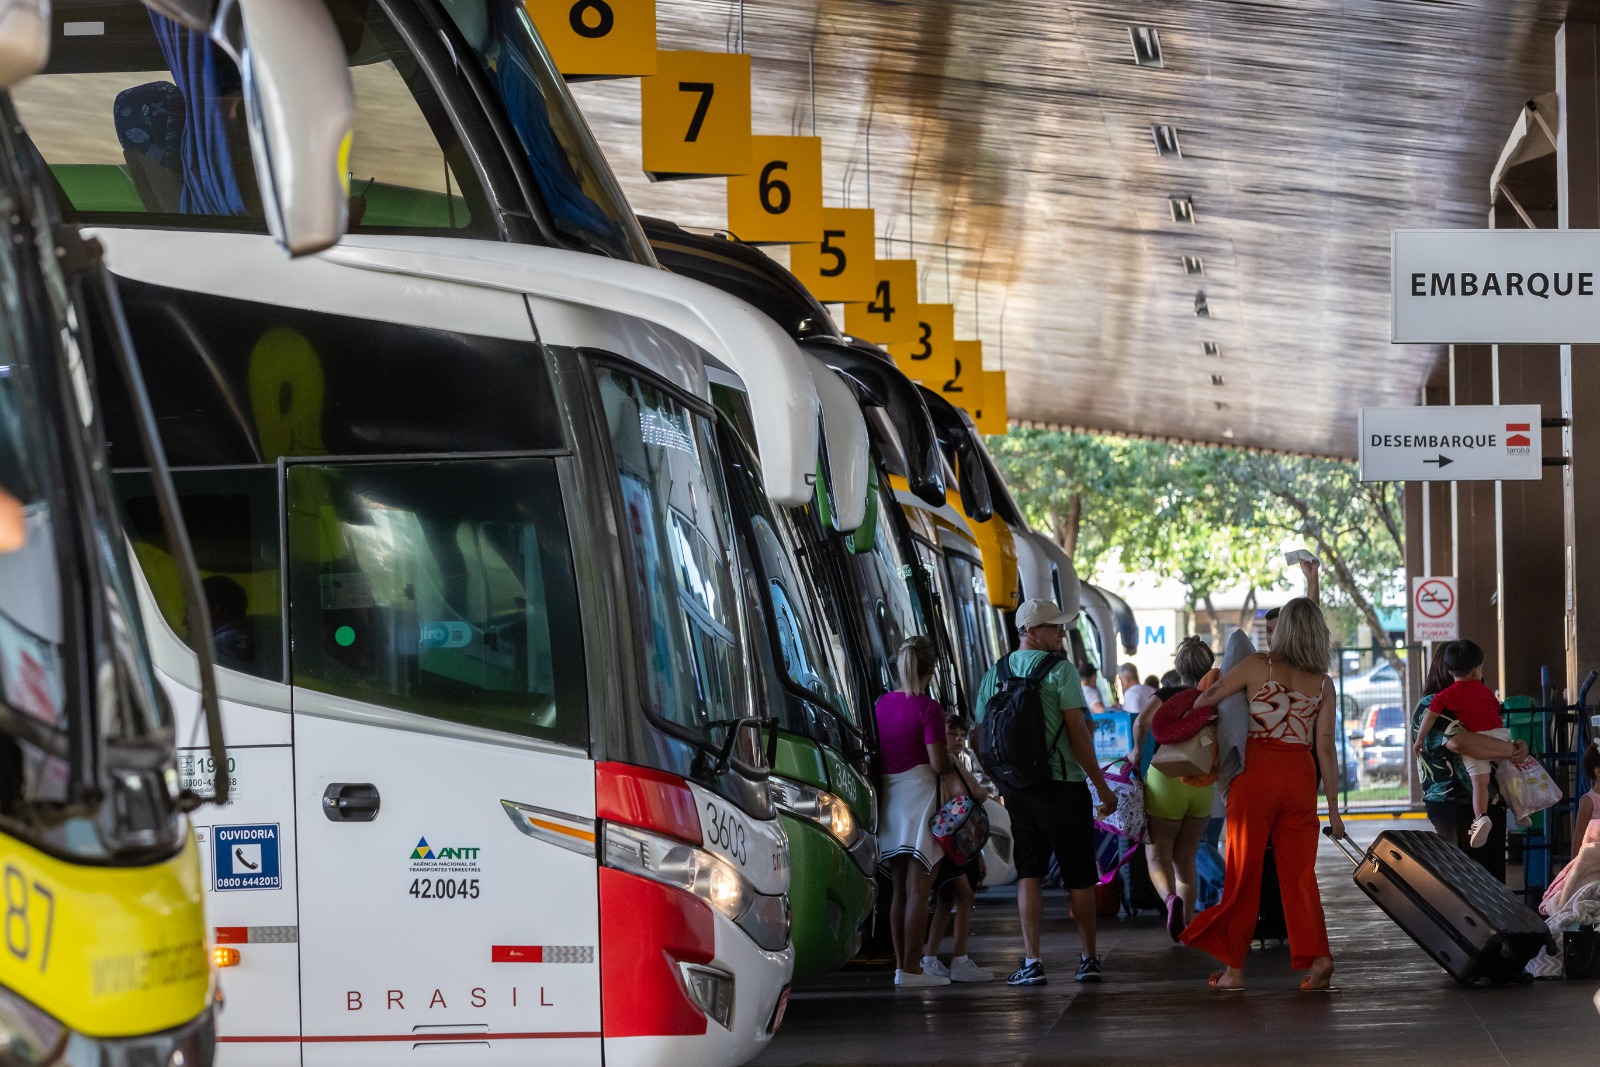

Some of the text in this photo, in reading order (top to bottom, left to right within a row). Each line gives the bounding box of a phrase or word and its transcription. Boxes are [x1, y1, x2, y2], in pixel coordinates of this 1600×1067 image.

[679, 82, 714, 142] 7
[759, 160, 791, 215] 6
[820, 230, 847, 277] 5
[1411, 272, 1594, 299] EMBARQUE
[867, 280, 895, 322] 4
[911, 321, 932, 360] 3
[942, 358, 963, 392] 2
[1371, 434, 1496, 449] DESEMBARQUE
[1136, 625, 1165, 645] M
[197, 757, 236, 773] 190
[220, 829, 275, 841] OUVIDORIA
[706, 802, 746, 866] 3603
[437, 848, 480, 859] ANTT
[218, 876, 279, 887] 0800 6442013
[409, 878, 480, 899] 42.0045
[346, 987, 554, 1011] BRASIL
